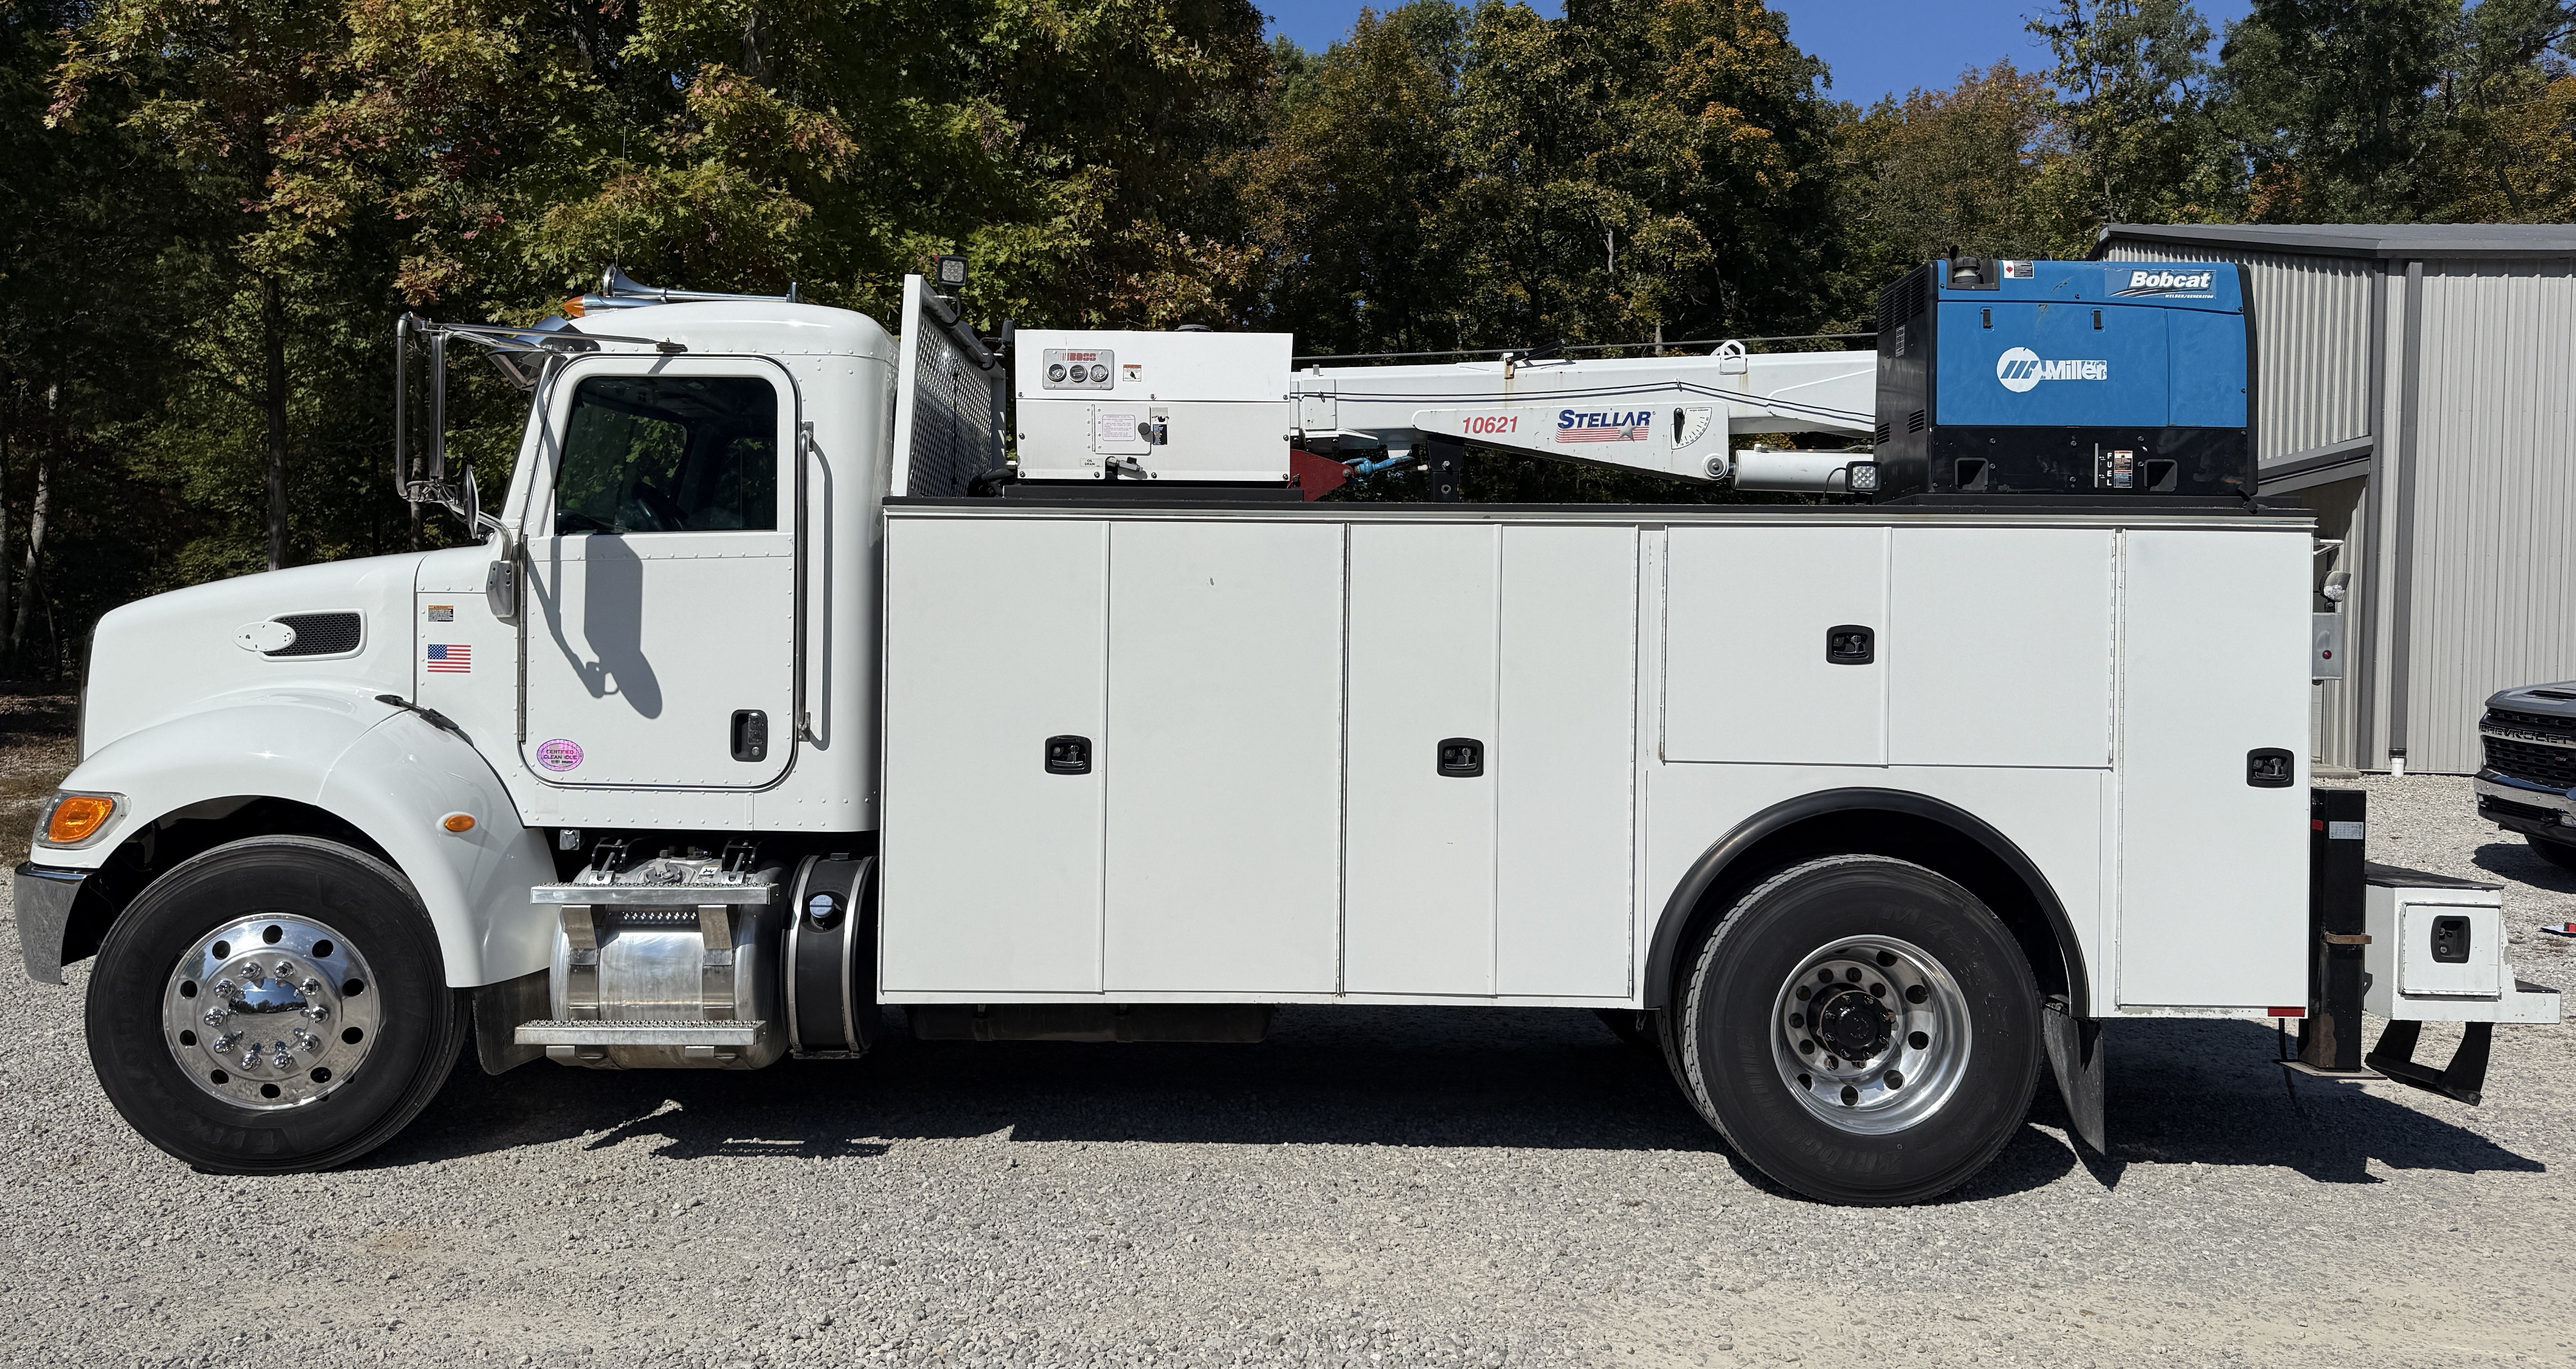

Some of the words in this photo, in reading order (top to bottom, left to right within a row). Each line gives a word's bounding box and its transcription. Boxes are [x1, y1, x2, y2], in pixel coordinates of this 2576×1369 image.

[2130, 272, 2211, 288] Bobcat
[1070, 353, 1096, 361] BOSS
[2044, 360, 2107, 380] Miller
[1462, 416, 1518, 434] 10621
[1557, 409, 1651, 429] STELLAR
[2480, 724, 2571, 744] CHEVROLET
